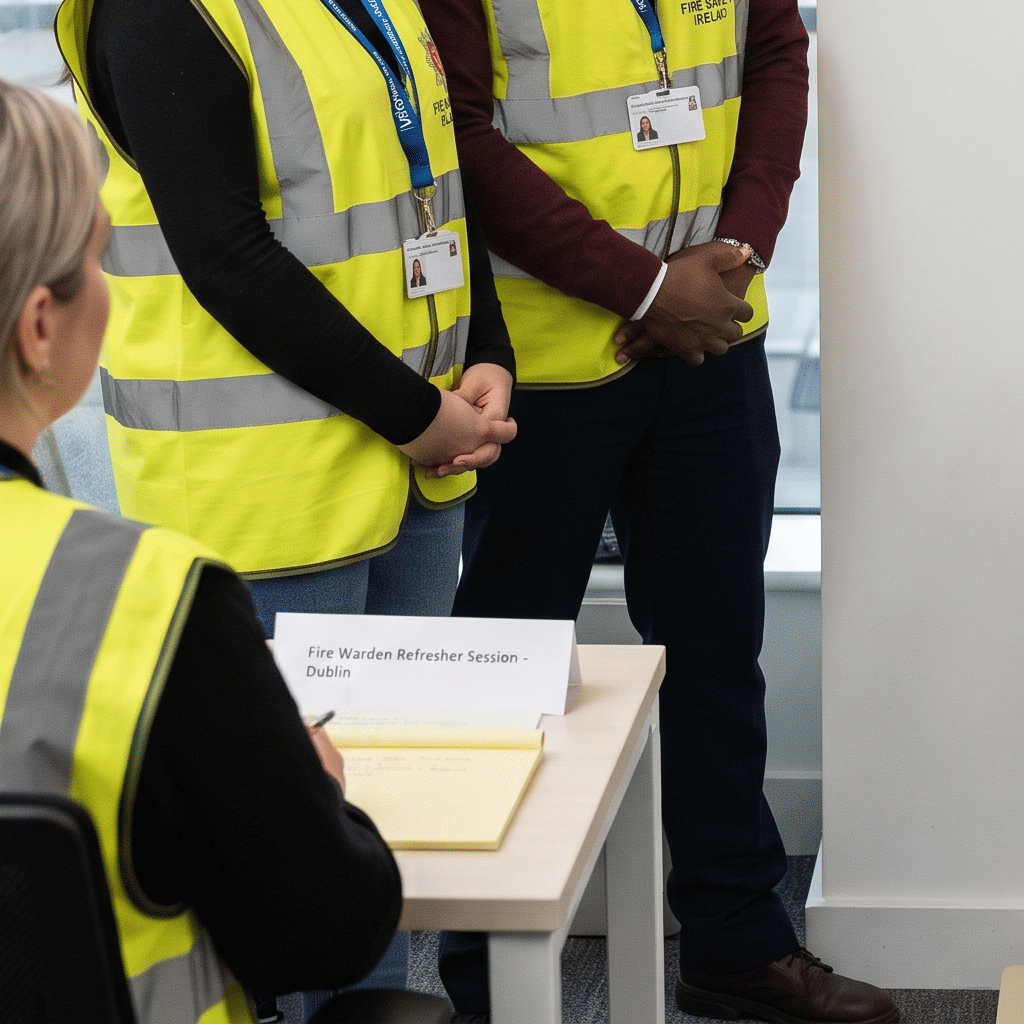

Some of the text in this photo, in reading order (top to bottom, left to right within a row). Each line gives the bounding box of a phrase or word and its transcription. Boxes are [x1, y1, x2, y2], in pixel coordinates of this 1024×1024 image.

[680, 0, 703, 14] FIRE
[308, 646, 334, 659] Fire
[338, 647, 392, 661] Warden
[396, 648, 464, 662] Refresher
[467, 650, 518, 664] Session
[306, 665, 351, 678] Dublin
